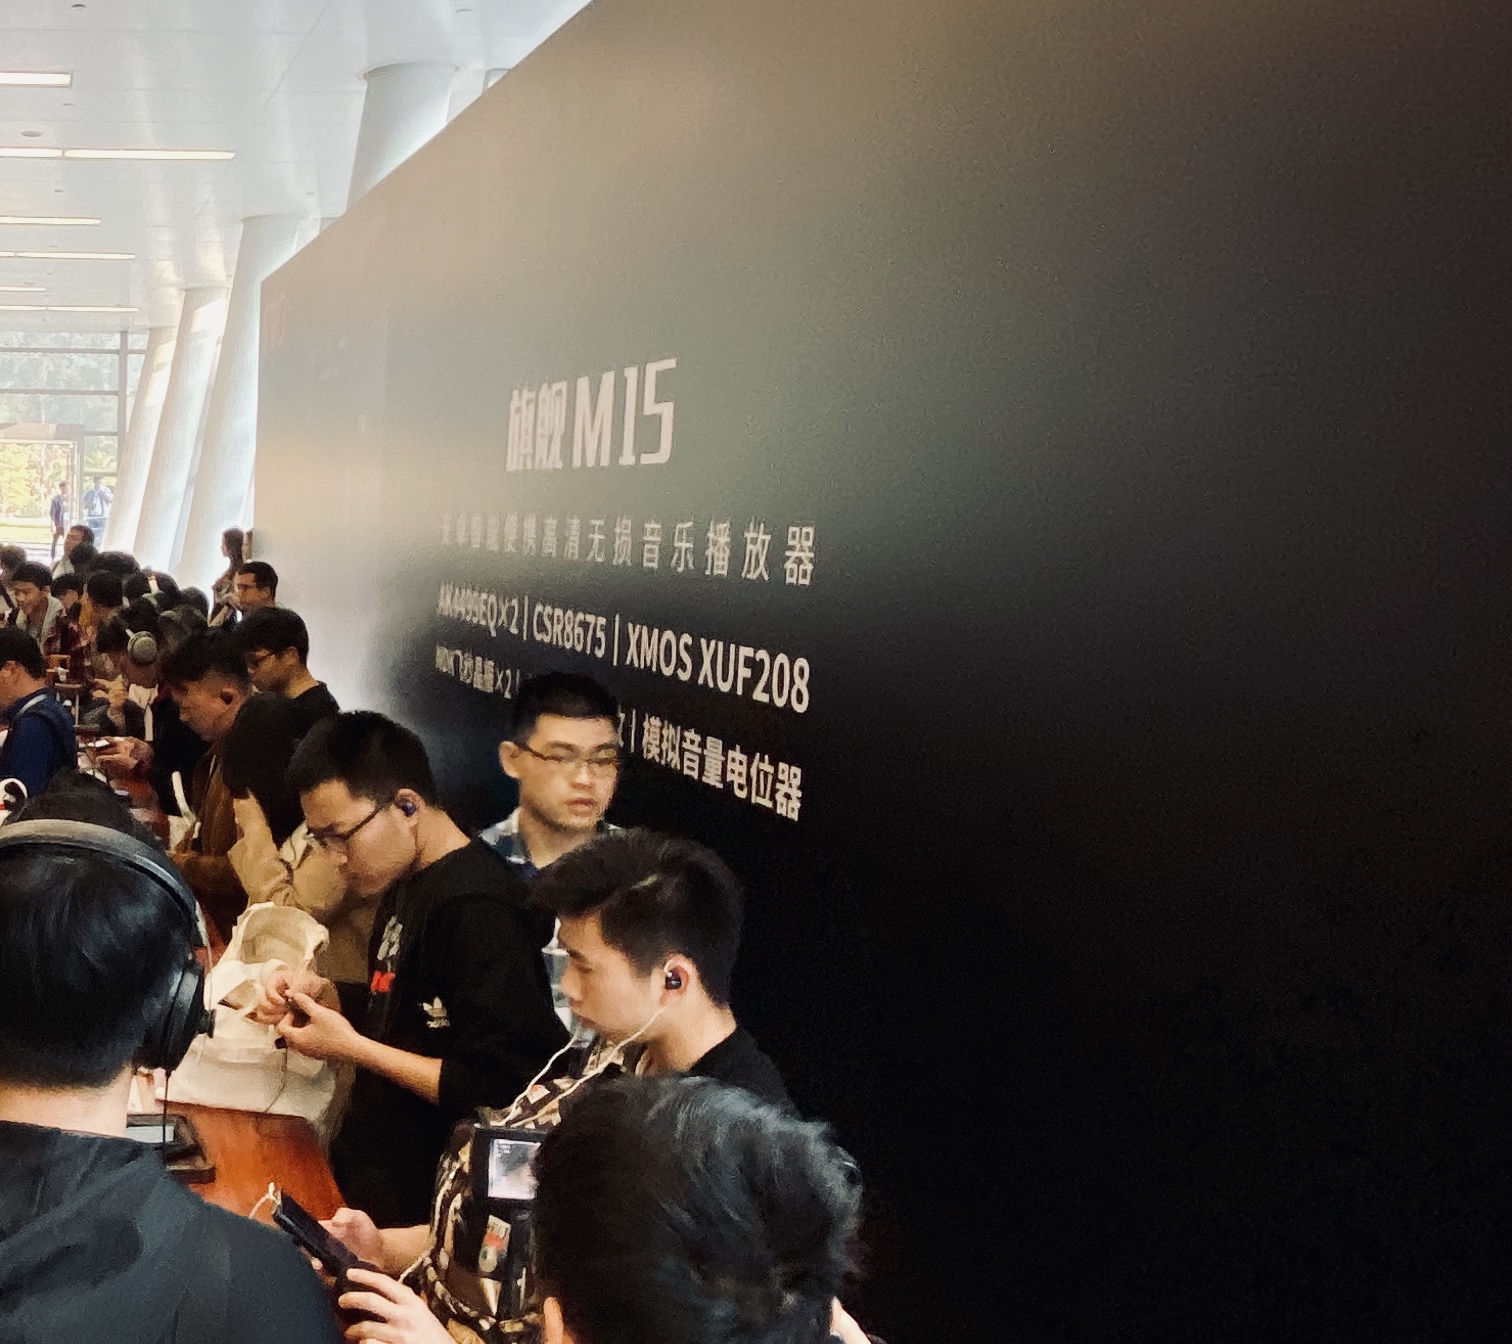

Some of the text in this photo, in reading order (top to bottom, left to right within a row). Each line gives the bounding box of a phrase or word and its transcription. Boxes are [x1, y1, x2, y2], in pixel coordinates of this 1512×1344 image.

[532, 602, 607, 659] CSR8675
[626, 622, 693, 682] XMOS
[698, 635, 810, 714] XUF208
[641, 712, 803, 822] 模拟音量电位器
